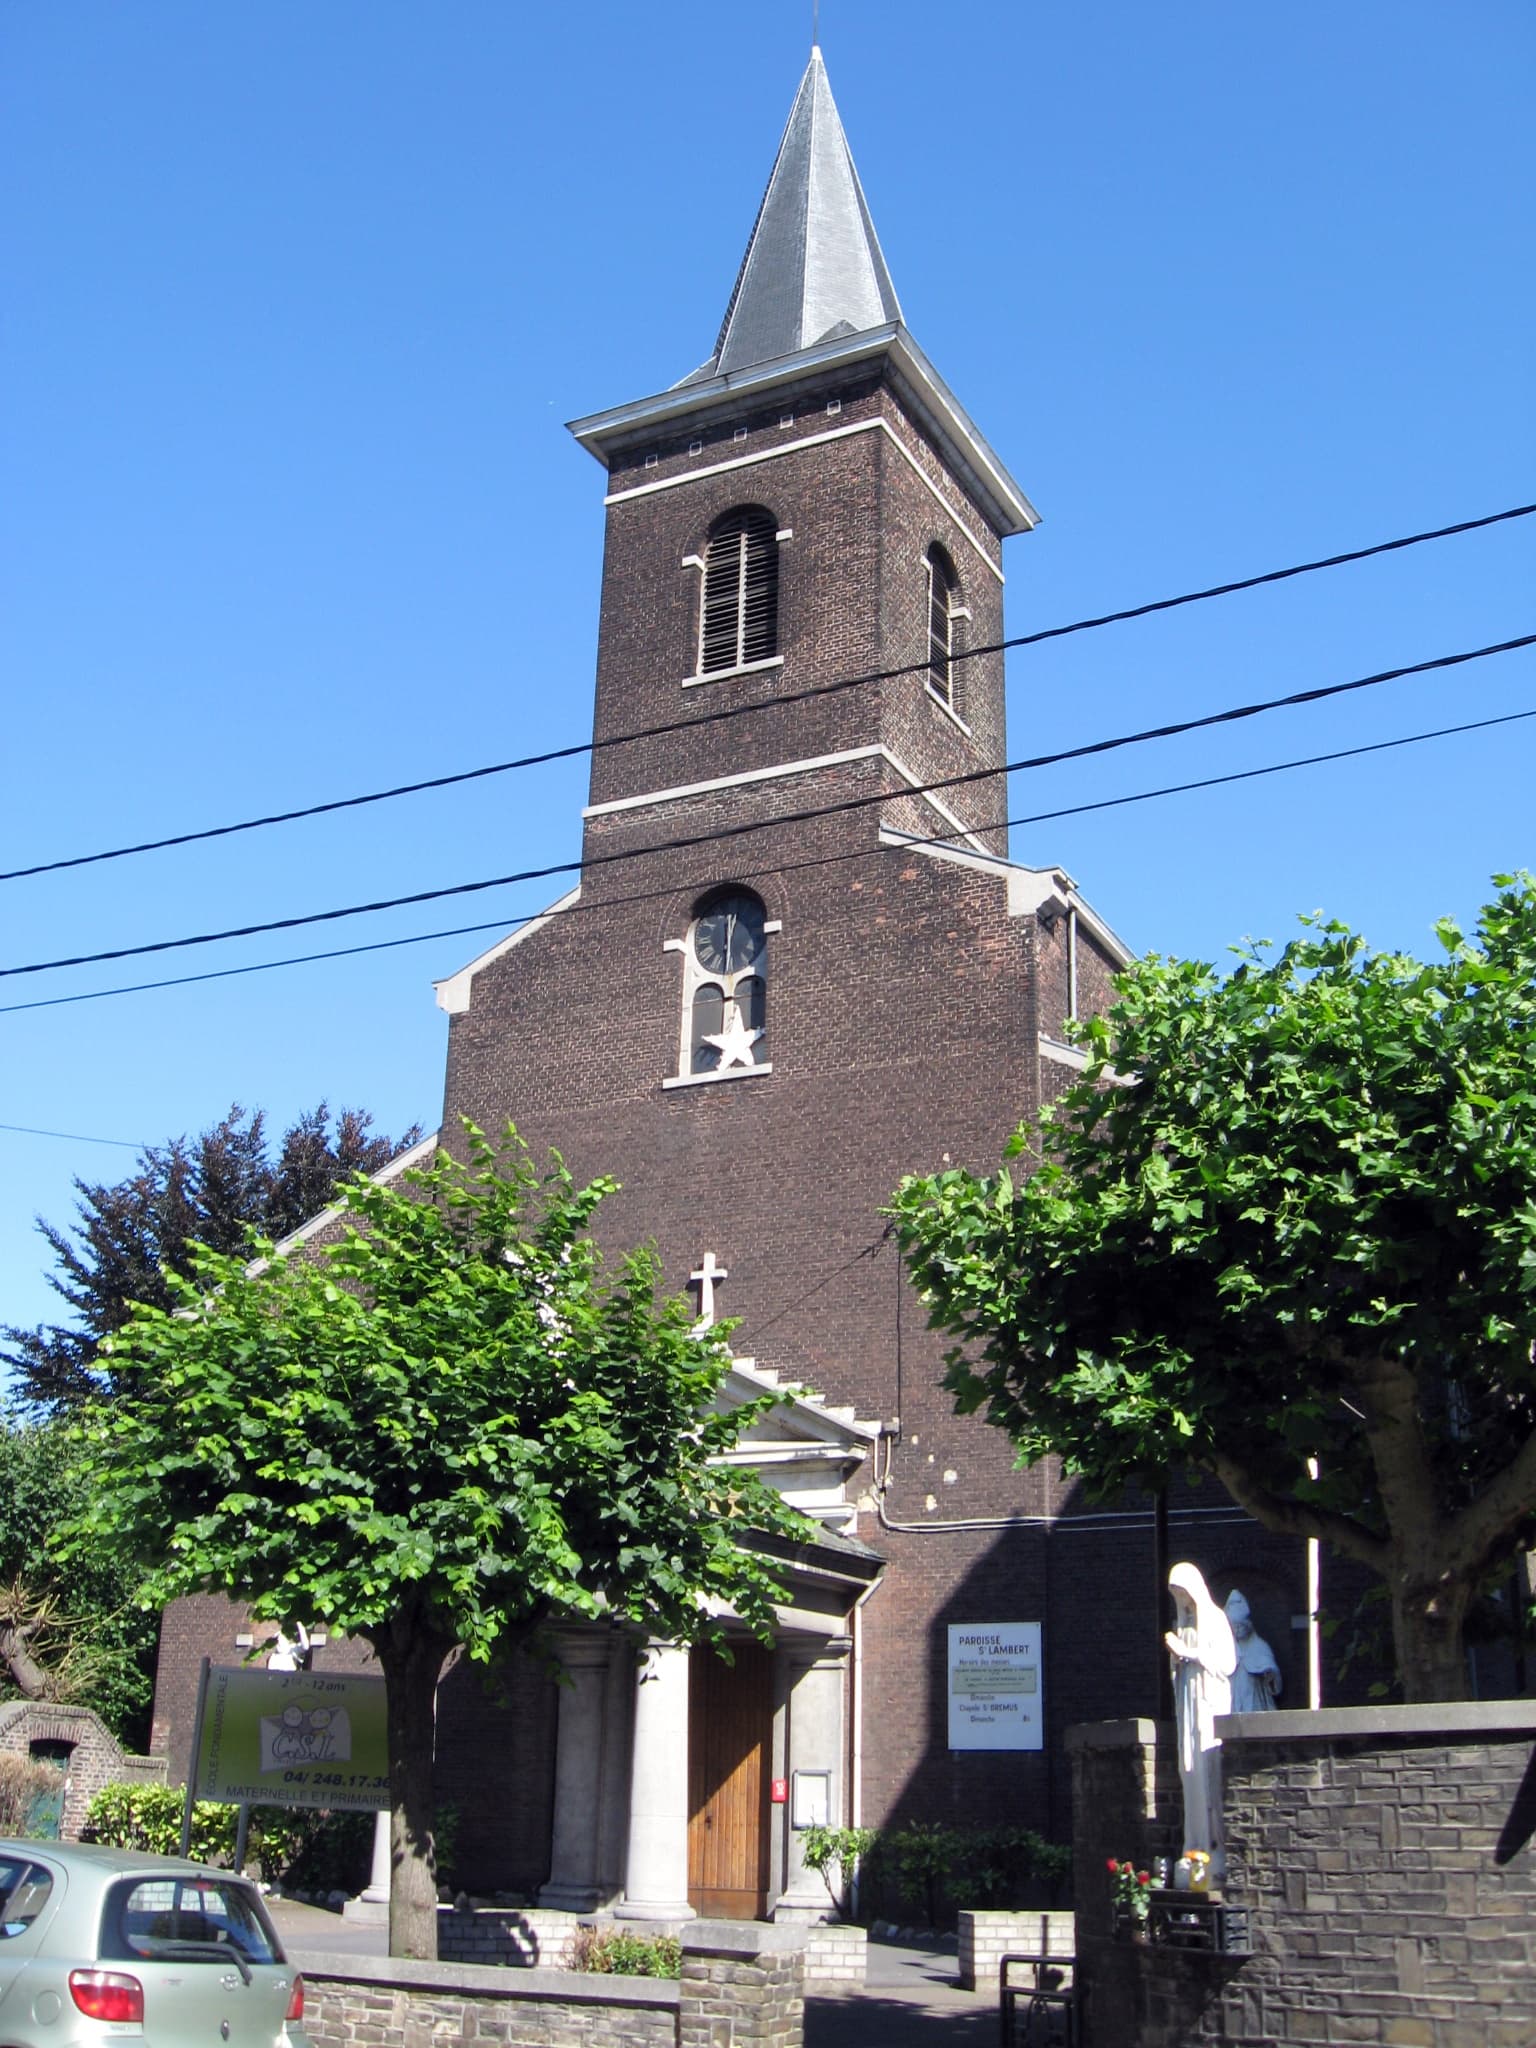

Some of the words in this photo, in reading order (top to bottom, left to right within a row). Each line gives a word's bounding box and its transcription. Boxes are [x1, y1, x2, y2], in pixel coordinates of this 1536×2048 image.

[959, 1635, 1001, 1646] PAROISSE
[988, 1645, 1030, 1655] LAMBERT
[313, 1679, 325, 1691] 12
[211, 1674, 228, 1758] FONDAMENTALE
[226, 1785, 309, 1801] MATERNELLE
[311, 1788, 328, 1801] ET
[330, 1790, 392, 1807] PRIMAIRE
